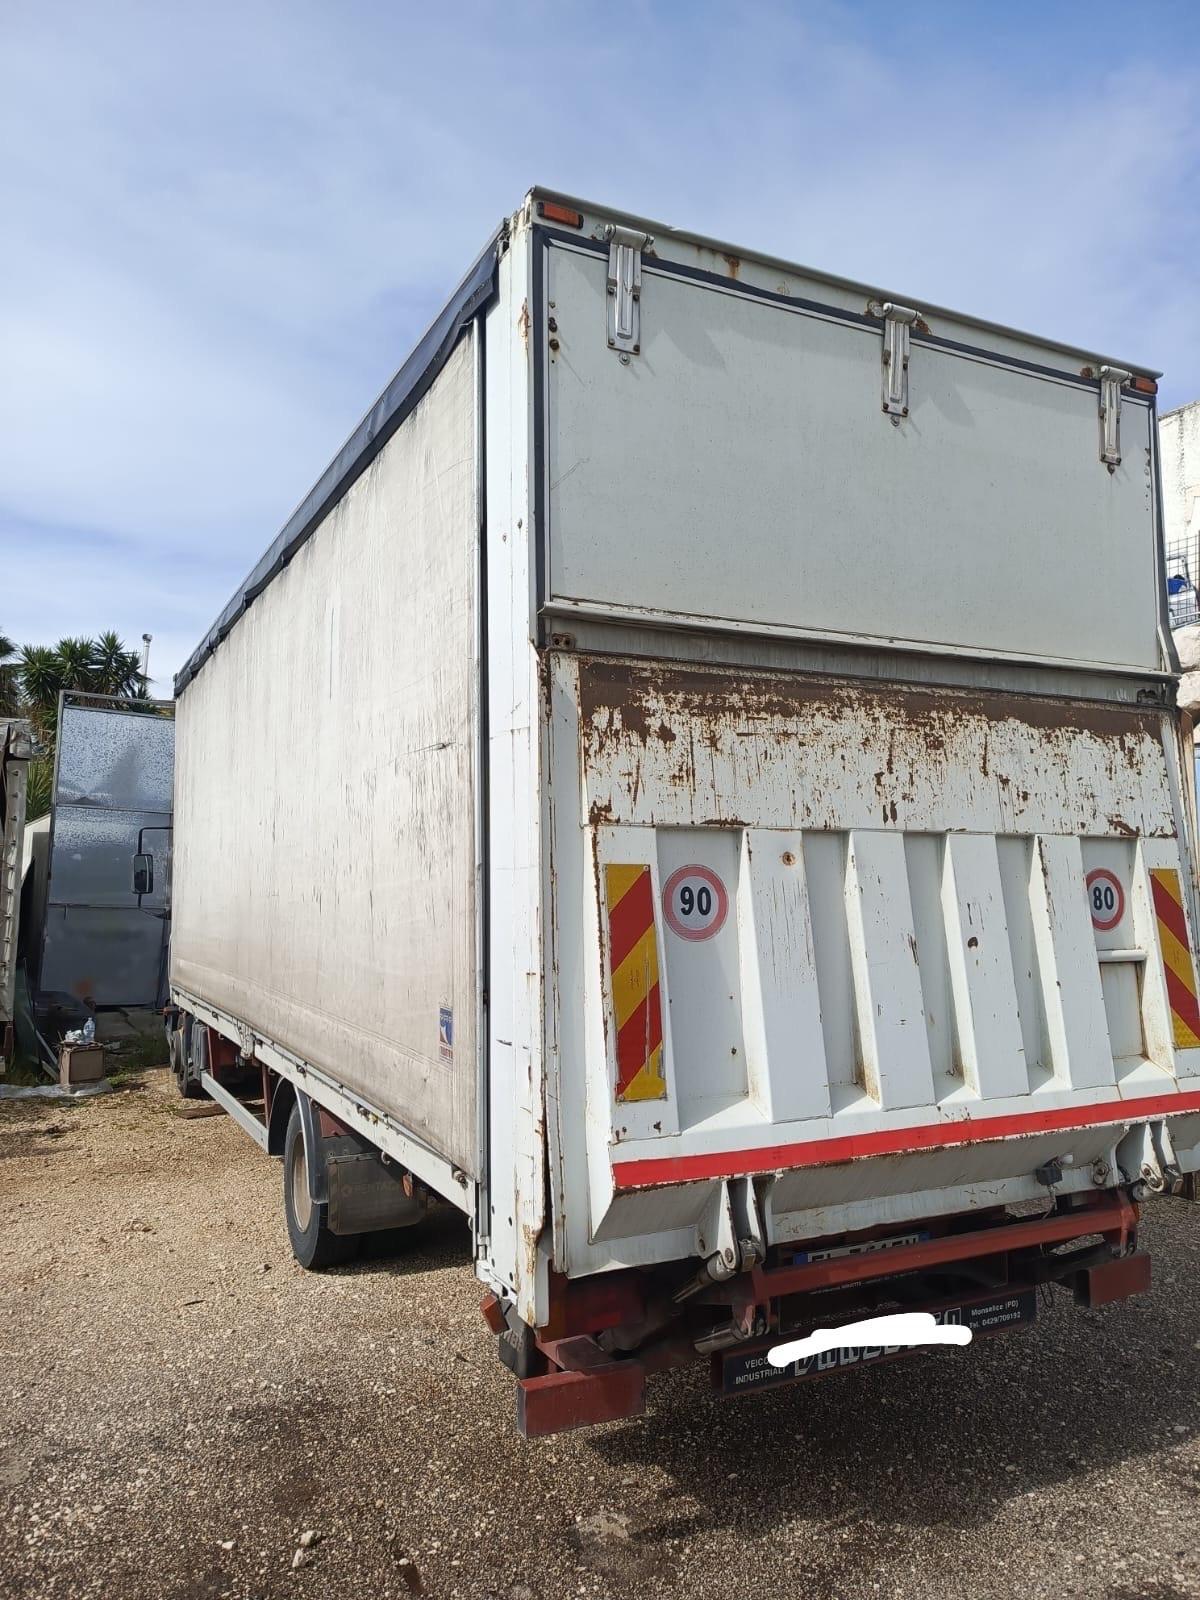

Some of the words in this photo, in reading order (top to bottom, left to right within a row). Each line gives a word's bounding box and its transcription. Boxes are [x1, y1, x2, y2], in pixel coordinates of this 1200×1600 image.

[680, 886, 712, 916] 90
[1093, 886, 1115, 911] 80
[971, 1304, 1004, 1317] Monselice
[1005, 1299, 1019, 1310] (PD)
[735, 1366, 786, 1385] INDUSTRIALI
